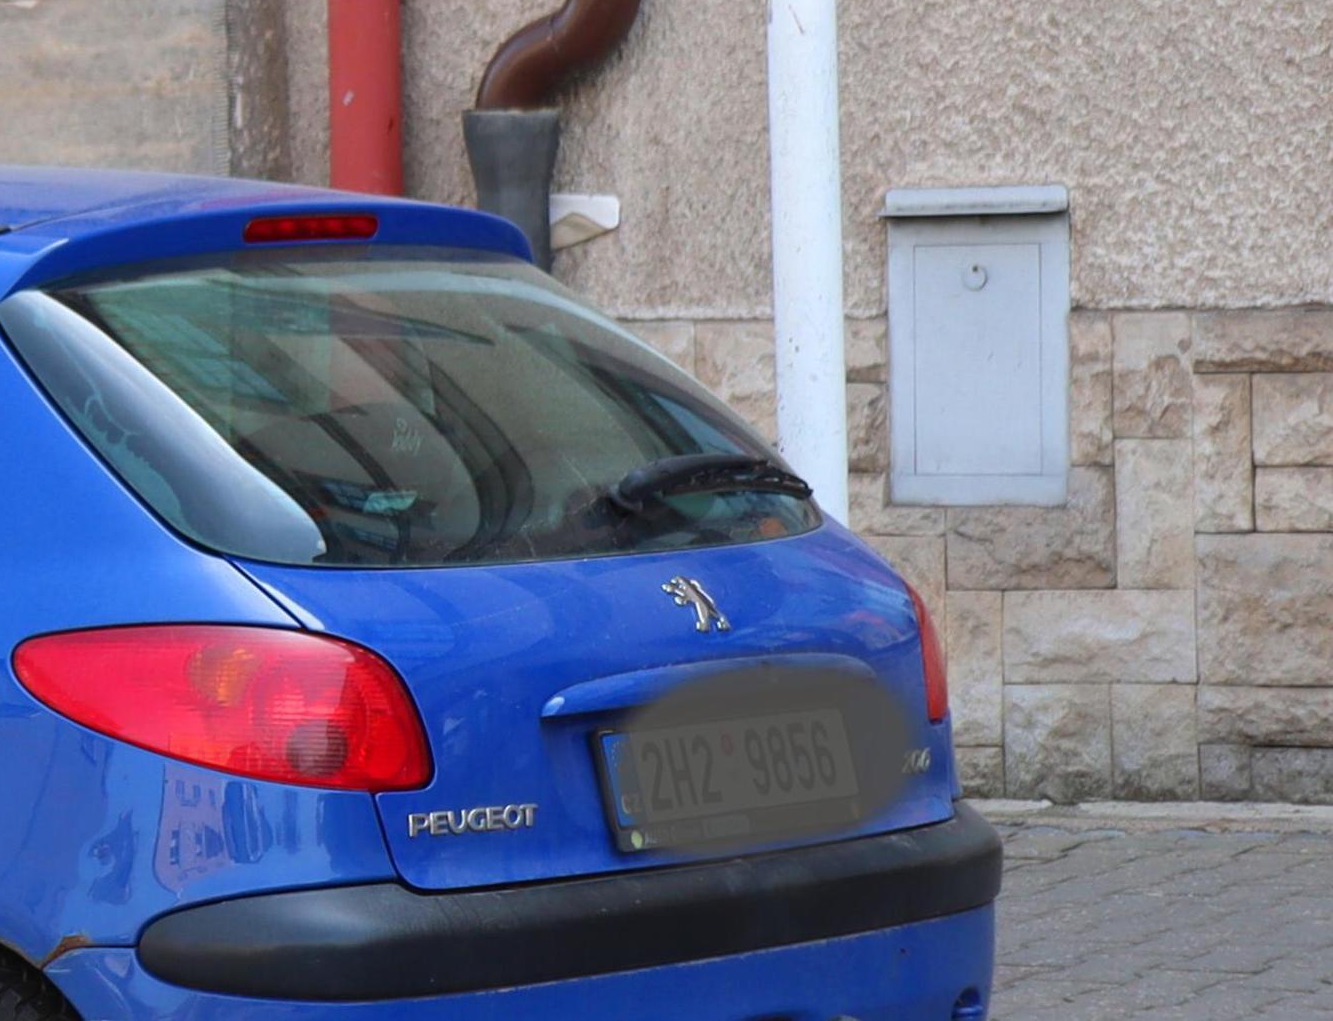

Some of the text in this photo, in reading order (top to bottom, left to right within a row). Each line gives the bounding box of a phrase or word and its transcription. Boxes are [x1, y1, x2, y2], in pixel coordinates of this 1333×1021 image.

[642, 720, 837, 811] 2H2 9856
[408, 803, 539, 838] PEUGEOT
